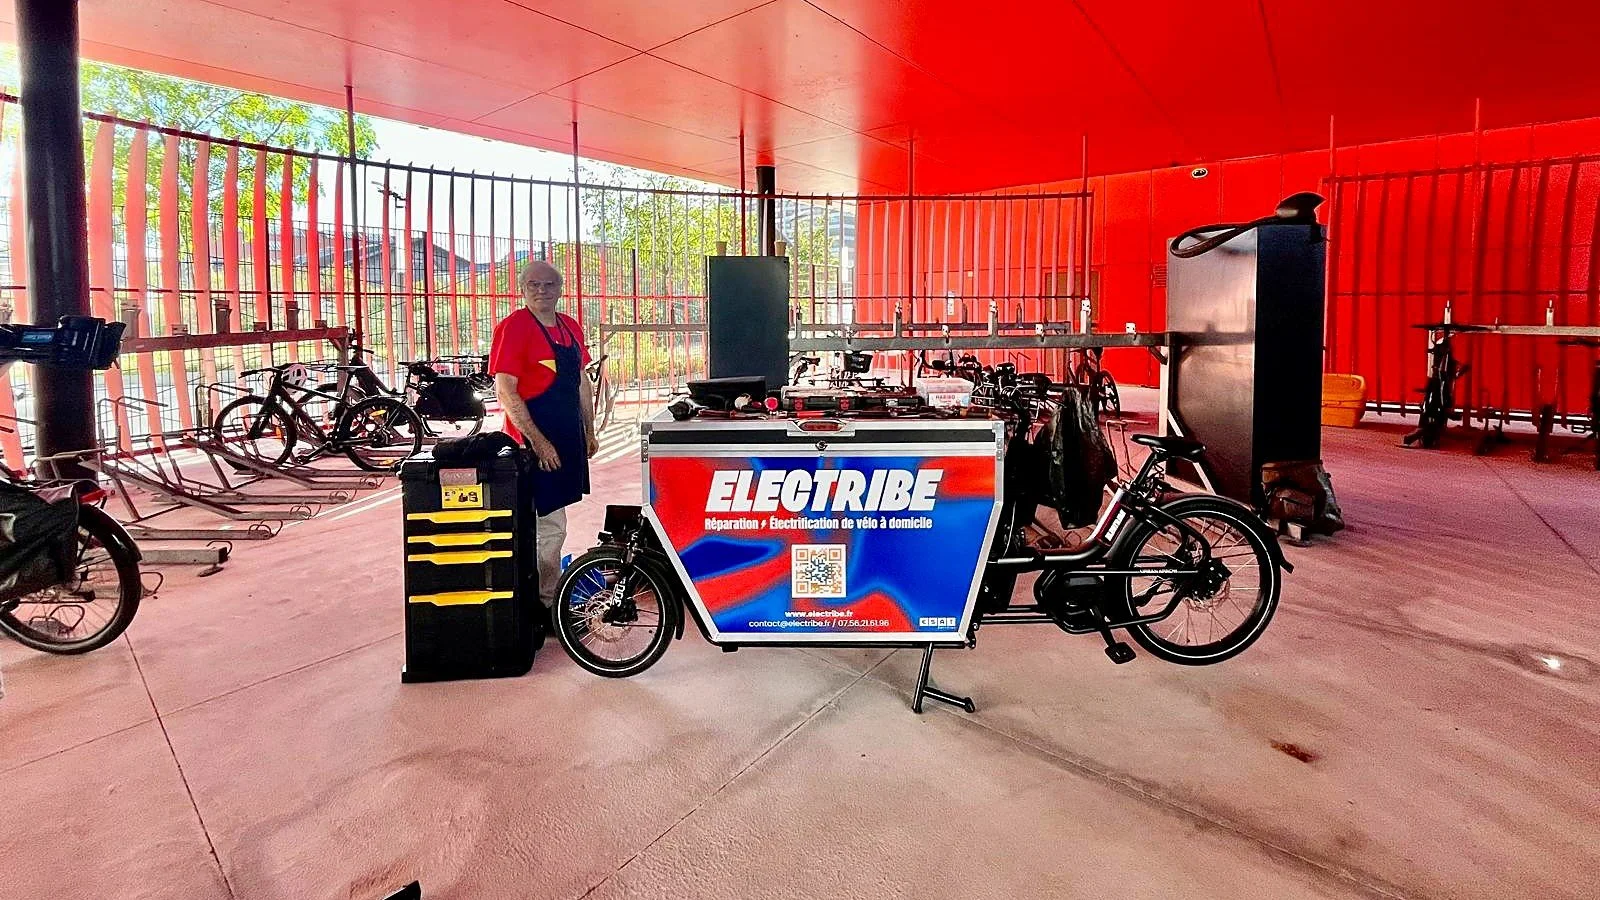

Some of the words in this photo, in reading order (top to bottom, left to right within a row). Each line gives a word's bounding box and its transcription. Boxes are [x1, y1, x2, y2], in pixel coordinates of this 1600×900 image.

[705, 469, 944, 512] ELECTRIBE
[704, 517, 759, 531] Réparation
[769, 515, 839, 529] Électrification
[841, 517, 854, 529] de
[856, 516, 878, 529] vélo
[880, 516, 887, 529] à
[889, 517, 933, 529] domicile
[748, 620, 830, 628] contact@electribe.fr
